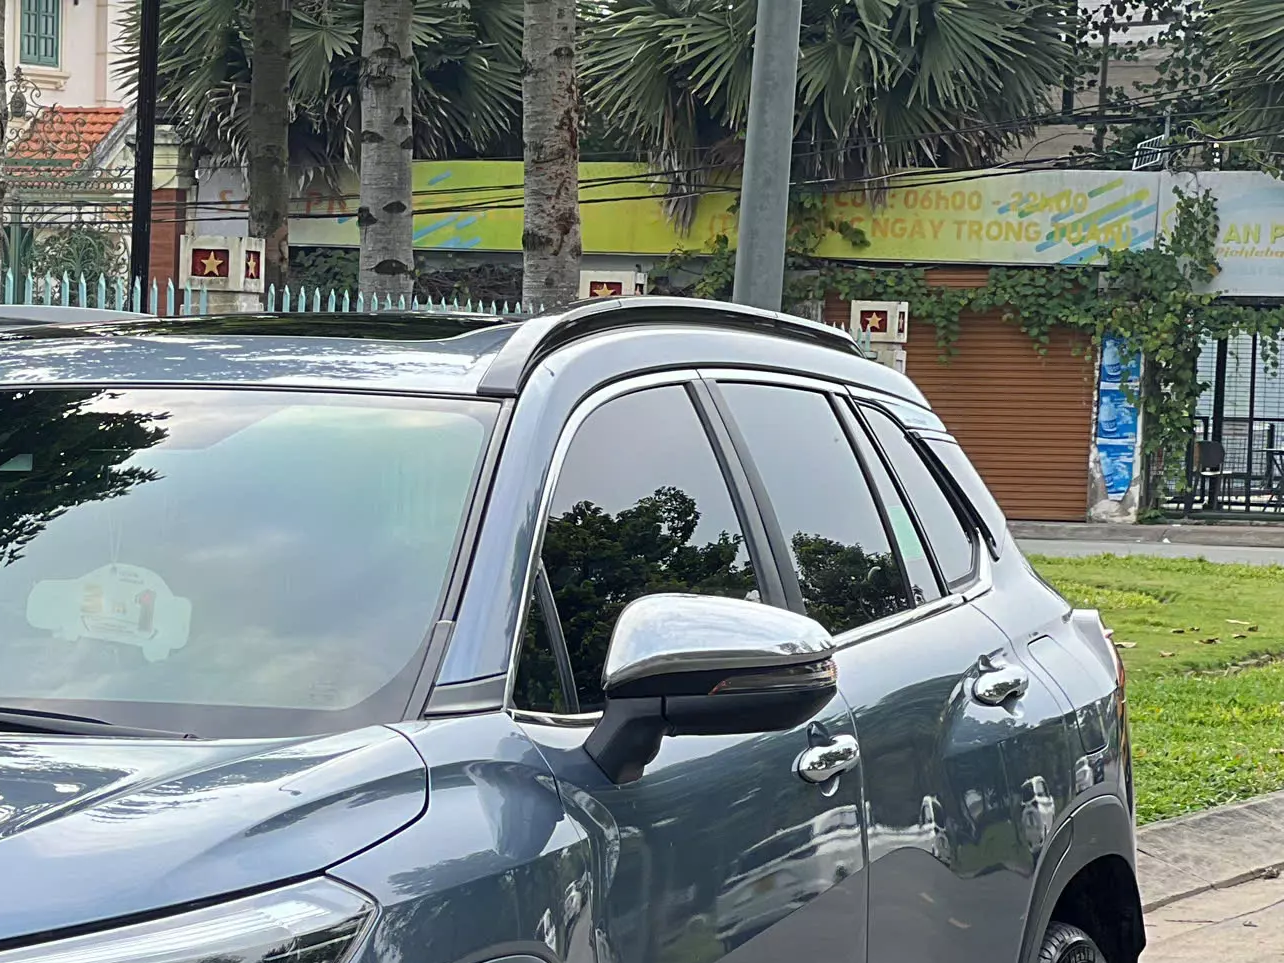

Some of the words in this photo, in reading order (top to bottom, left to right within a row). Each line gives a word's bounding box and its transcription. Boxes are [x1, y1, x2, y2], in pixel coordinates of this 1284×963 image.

[903, 188, 982, 211] 06h00
[870, 211, 945, 240] NGÀY
[952, 218, 1042, 242] TRONG
